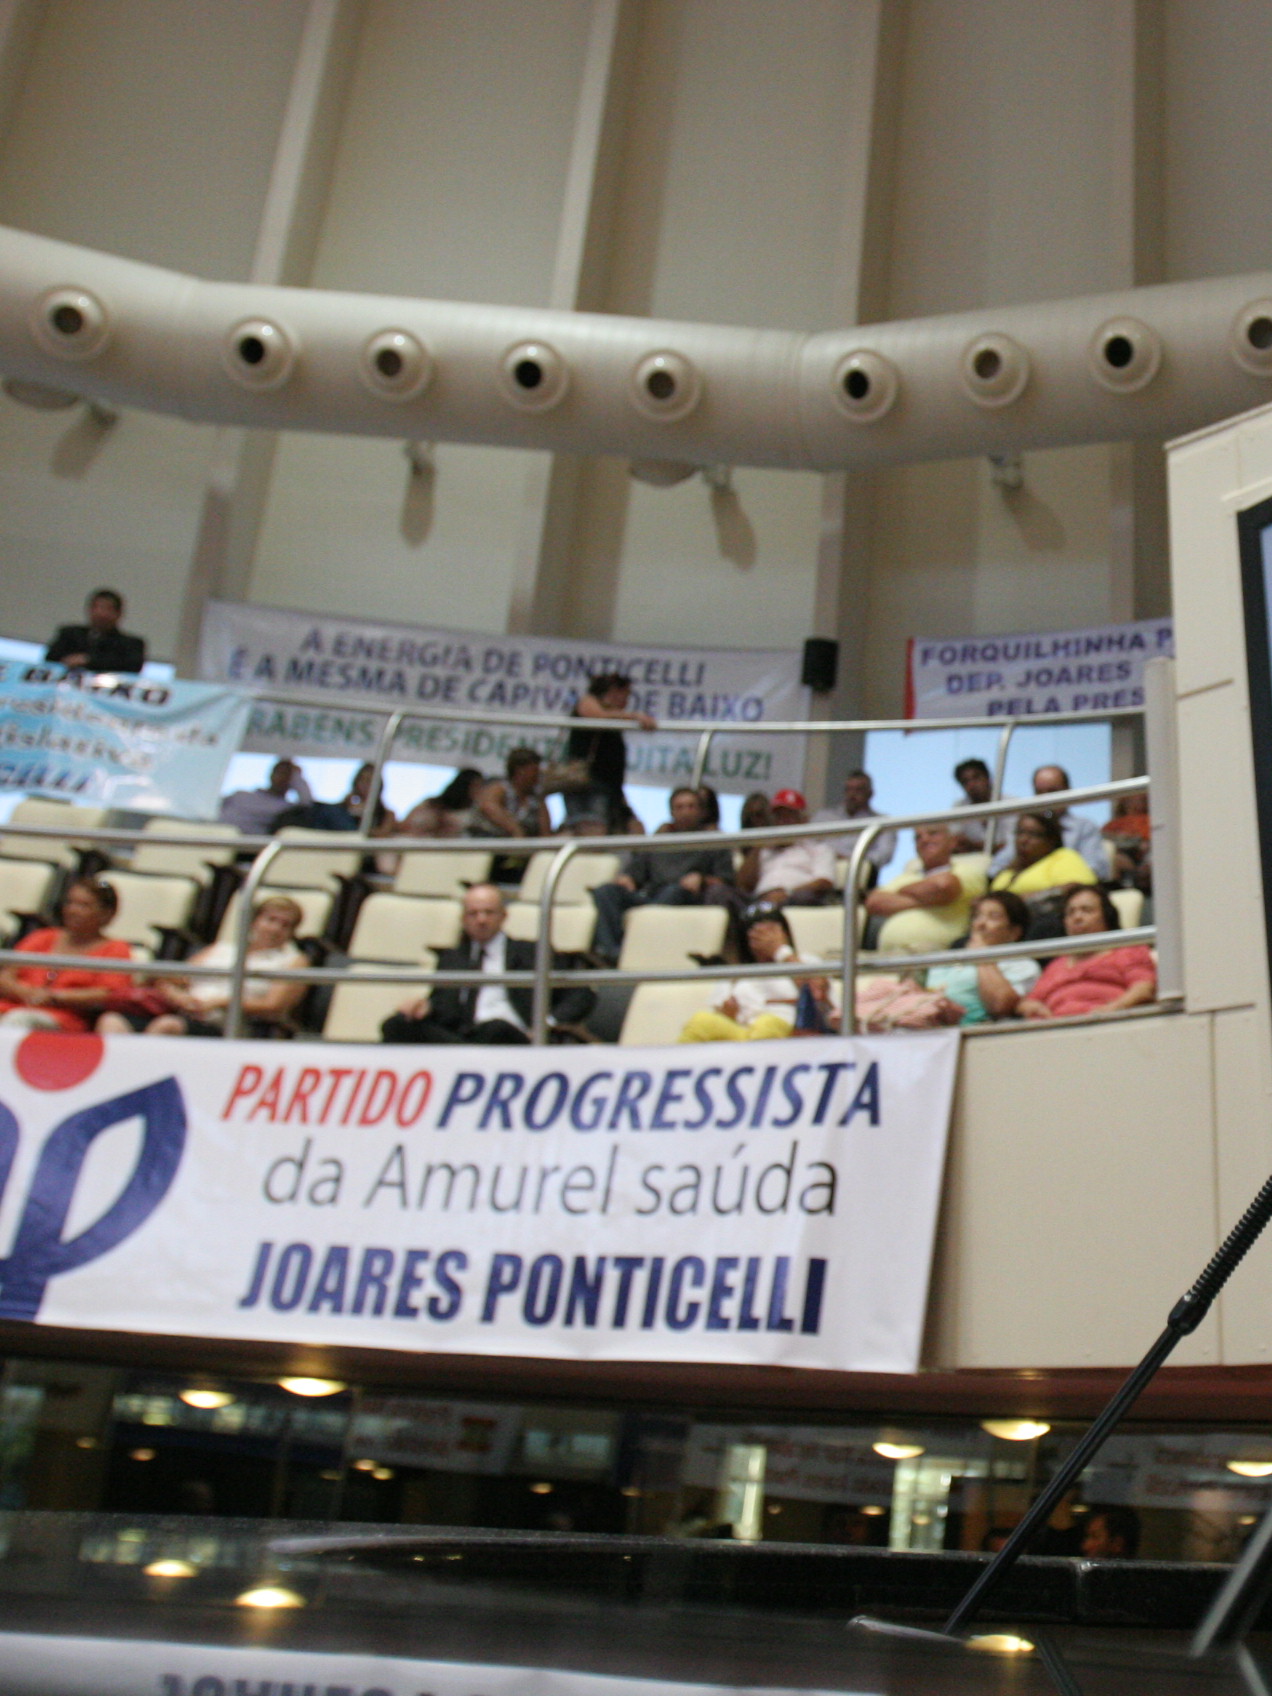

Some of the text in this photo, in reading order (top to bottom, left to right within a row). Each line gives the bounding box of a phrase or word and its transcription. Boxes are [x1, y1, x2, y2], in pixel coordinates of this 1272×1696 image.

[302, 628, 705, 686] A ENERGIA DE PONTICELLI
[920, 630, 1146, 668] FORQUILHINHA
[945, 660, 1132, 696] DEP. JOARES
[254, 654, 275, 680] A
[285, 656, 407, 694] MESMA
[416, 670, 460, 700] DE
[667, 690, 765, 722] BAIXO
[986, 699, 1061, 719] PELA
[221, 1061, 881, 1131] PARTIDO PROGRESSISTA
[263, 1136, 838, 1218] da Amurel saúda
[238, 1242, 828, 1336] JOARES PONTICELLI
